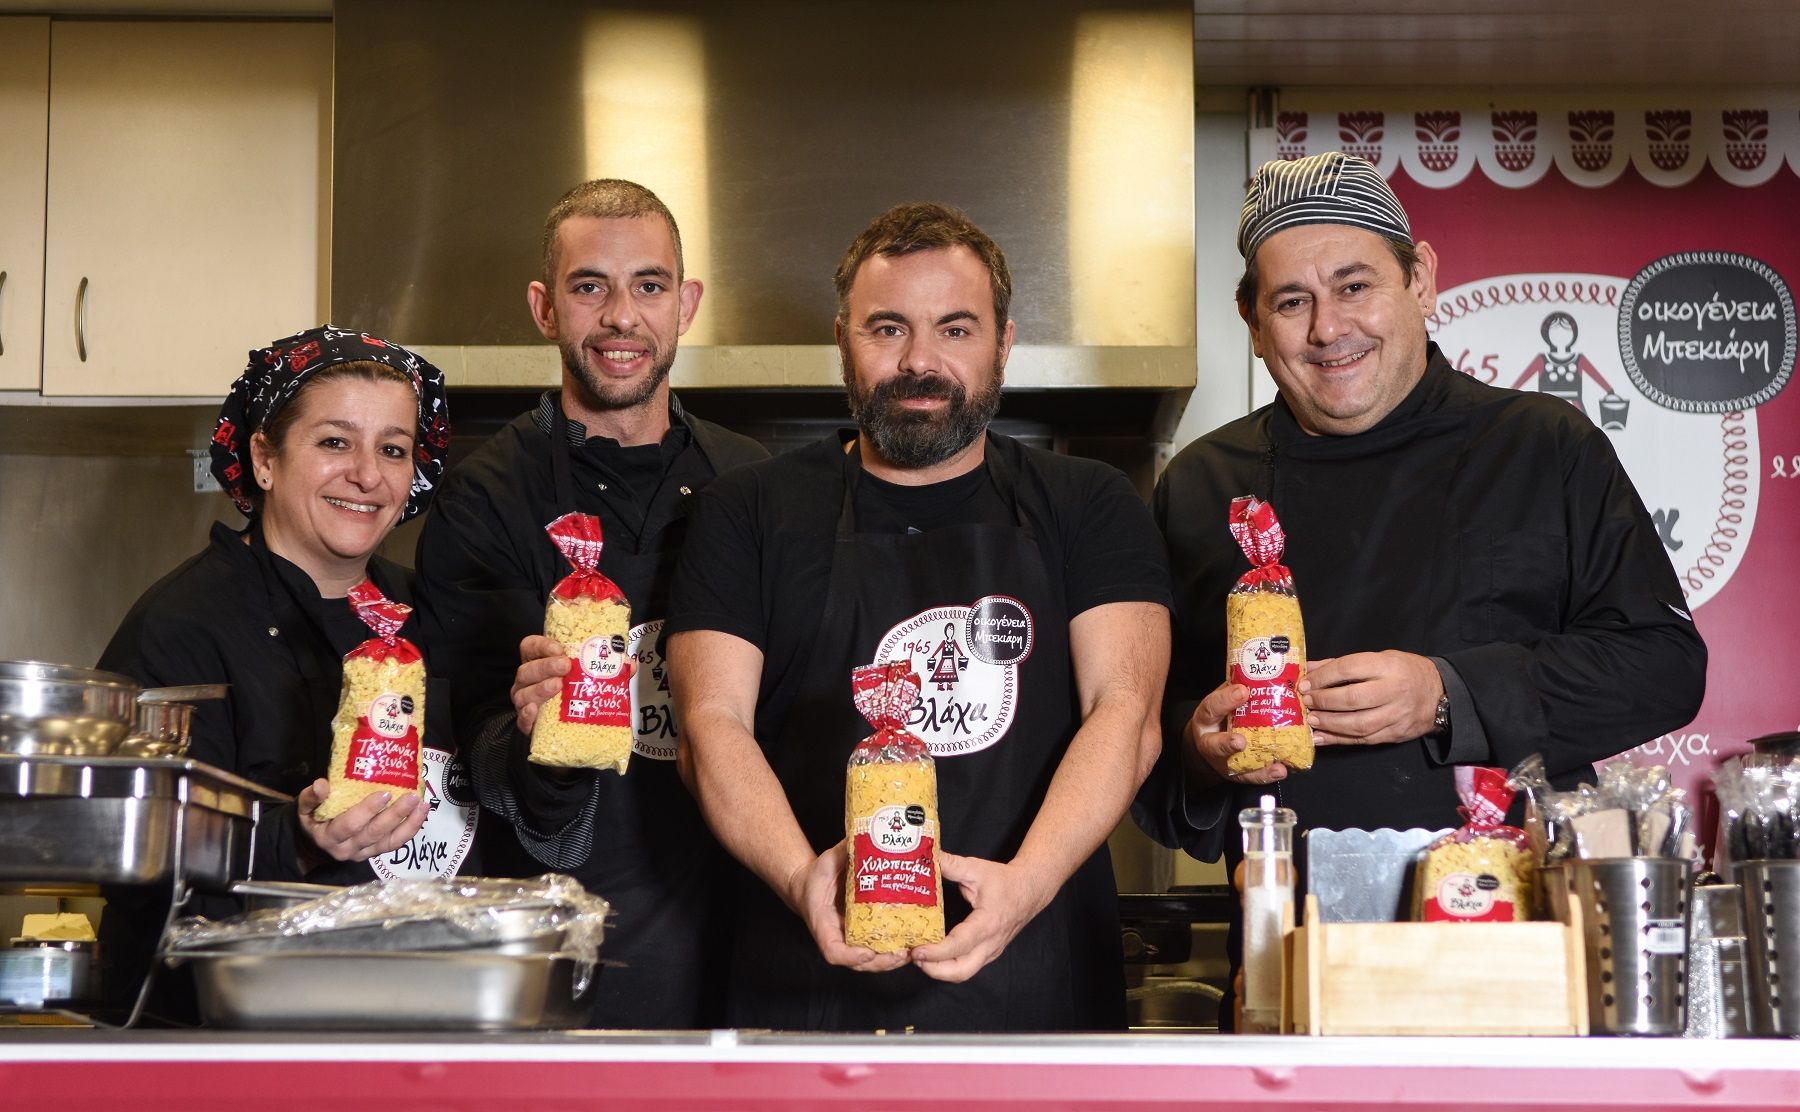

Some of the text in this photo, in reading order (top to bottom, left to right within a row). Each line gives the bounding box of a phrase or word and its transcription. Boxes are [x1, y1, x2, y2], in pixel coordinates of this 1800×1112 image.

[1637, 292, 1777, 331] οικογένεια
[1642, 328, 1771, 374] Μπεκιάρη
[973, 614, 1026, 631] οικογένεια
[974, 629, 1023, 650] Μπεκιάρη
[903, 639, 931, 660] 1965
[589, 660, 617, 673] Βλάχα
[569, 681, 629, 700] Τραχανάς
[592, 695, 621, 711] ξινός
[1260, 699, 1281, 708] αυγ
[906, 696, 988, 735] Βλάχα
[378, 719, 405, 733] Βλάχα
[357, 737, 416, 762] Τραχανάς
[378, 755, 409, 770] ξινός
[881, 832, 912, 847] Βλάχα
[881, 873, 916, 884] με αυγά
